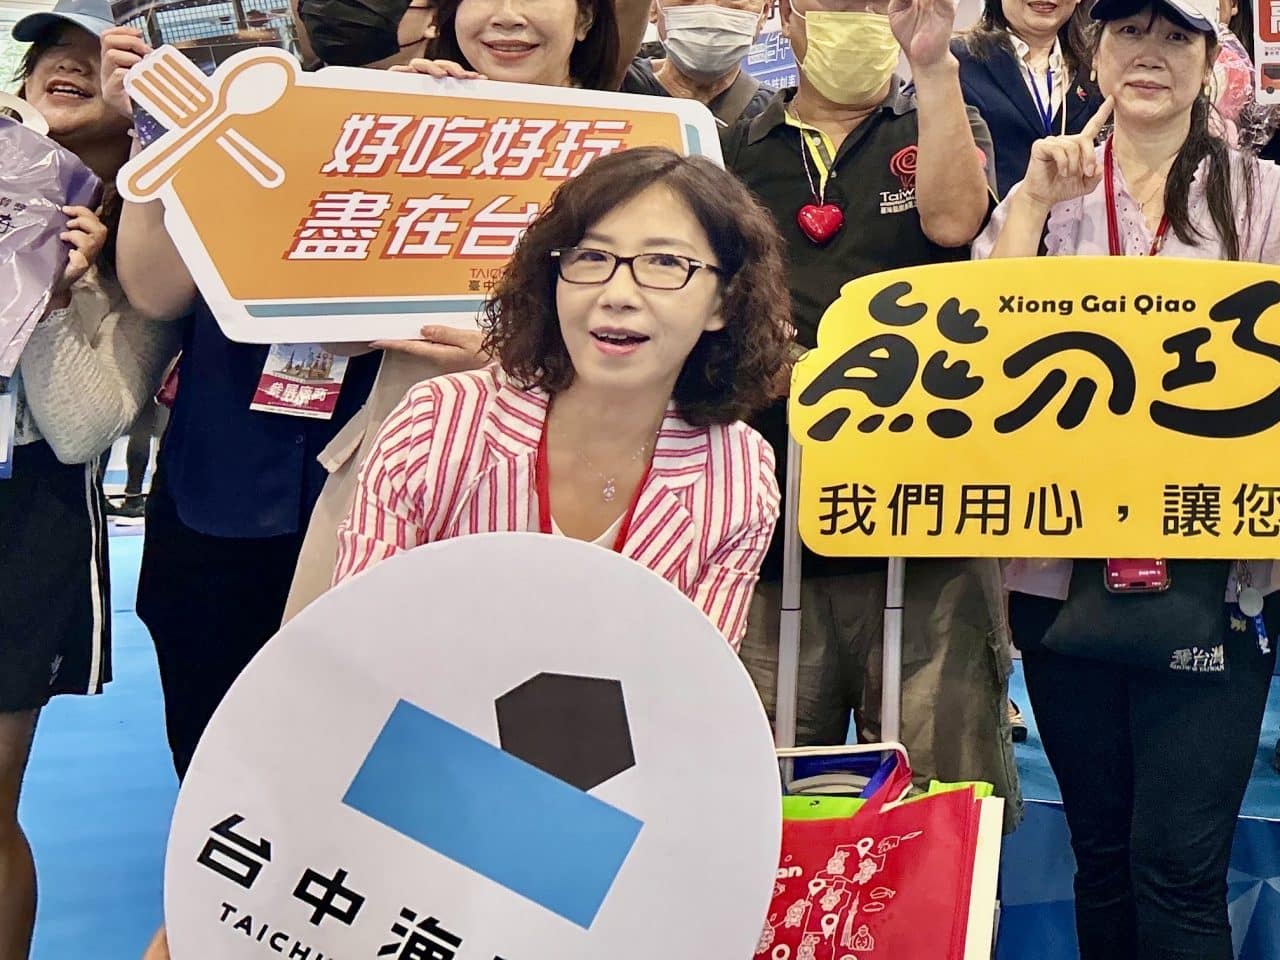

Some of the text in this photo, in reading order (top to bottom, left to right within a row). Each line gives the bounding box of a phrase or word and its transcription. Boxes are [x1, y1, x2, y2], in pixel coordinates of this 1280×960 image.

[322, 114, 632, 178] 好吃好玩
[285, 192, 540, 260] 盡在台
[880, 188, 915, 202] Taiw
[999, 295, 1197, 316] Xiong Gai Qiao
[197, 814, 510, 960] 台中海
